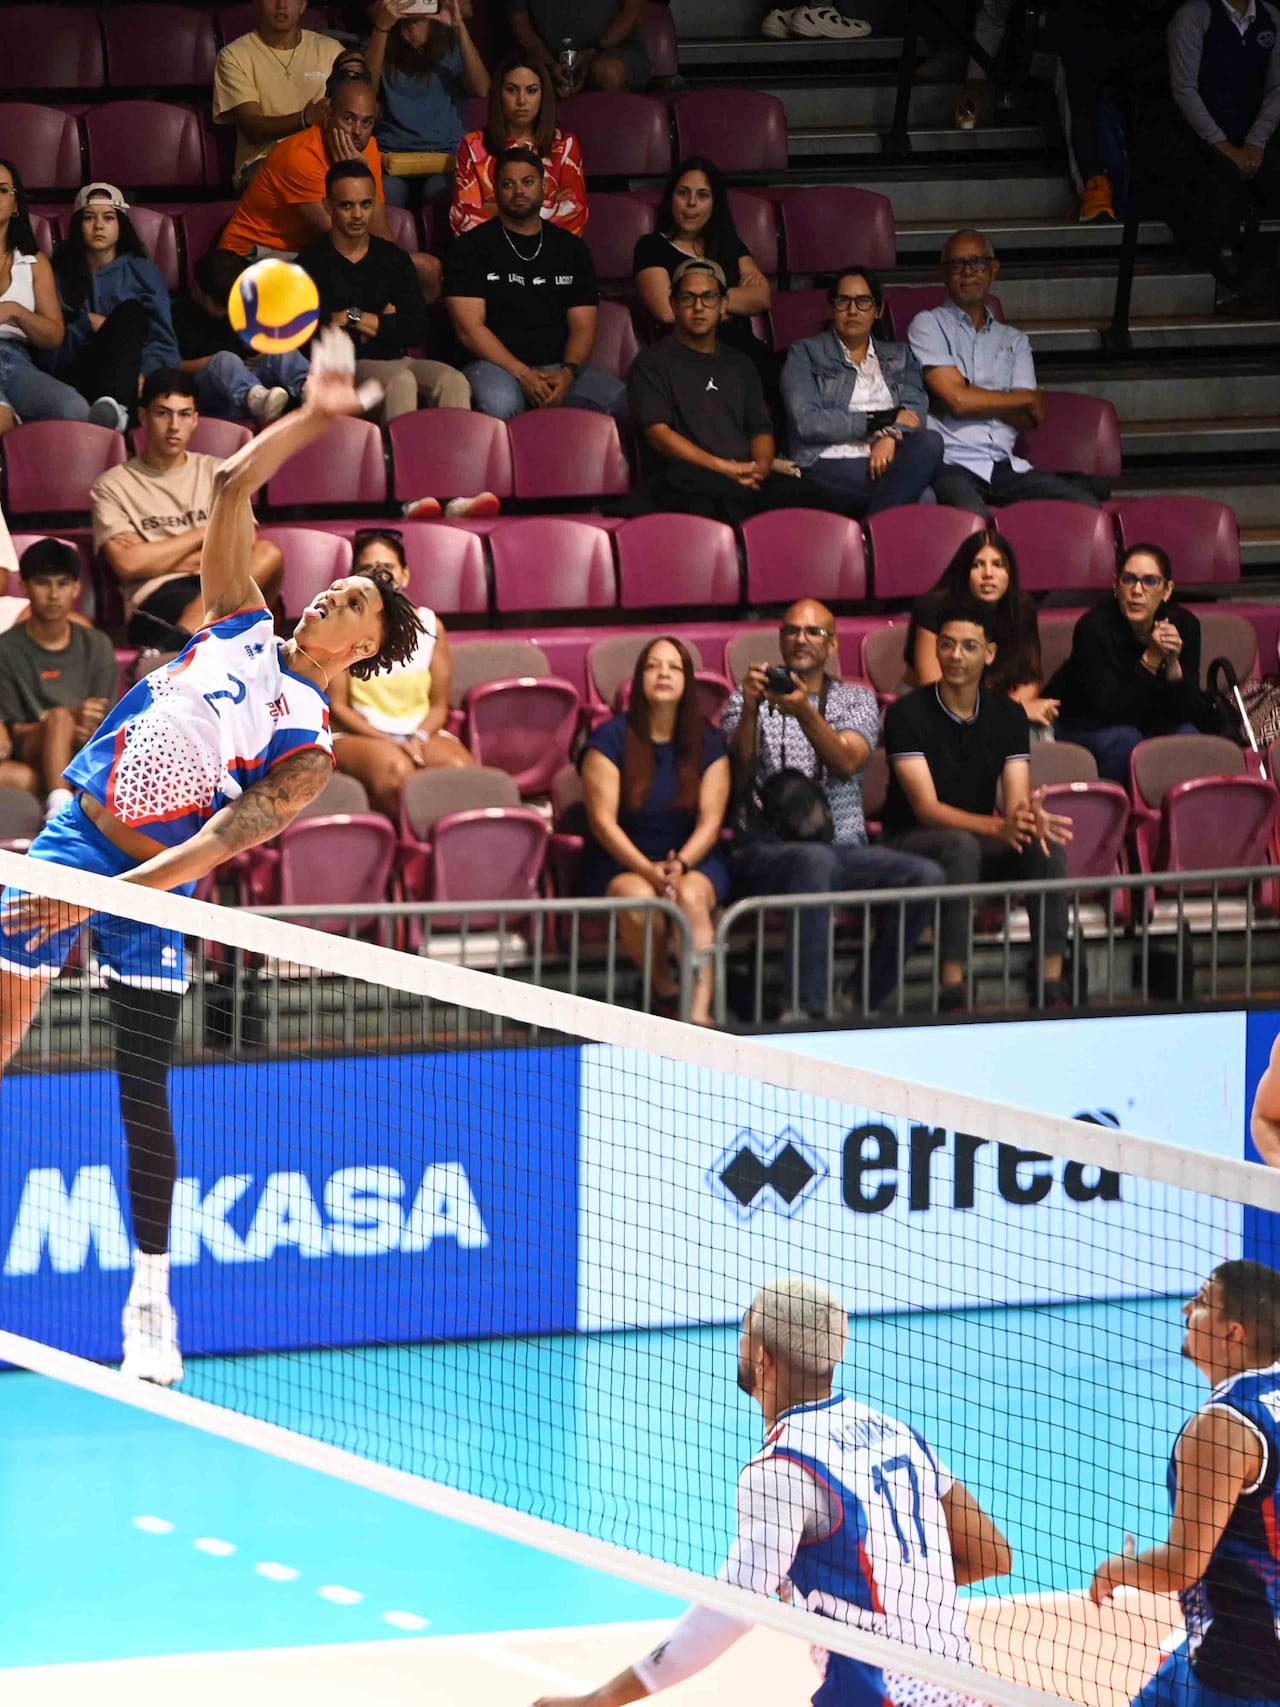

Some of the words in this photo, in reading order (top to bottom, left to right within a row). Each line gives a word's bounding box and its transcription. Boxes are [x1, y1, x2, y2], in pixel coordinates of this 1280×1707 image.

[203, 673, 246, 719] 2
[3, 1161, 491, 1277] MKASA
[871, 1454, 929, 1564] 17
